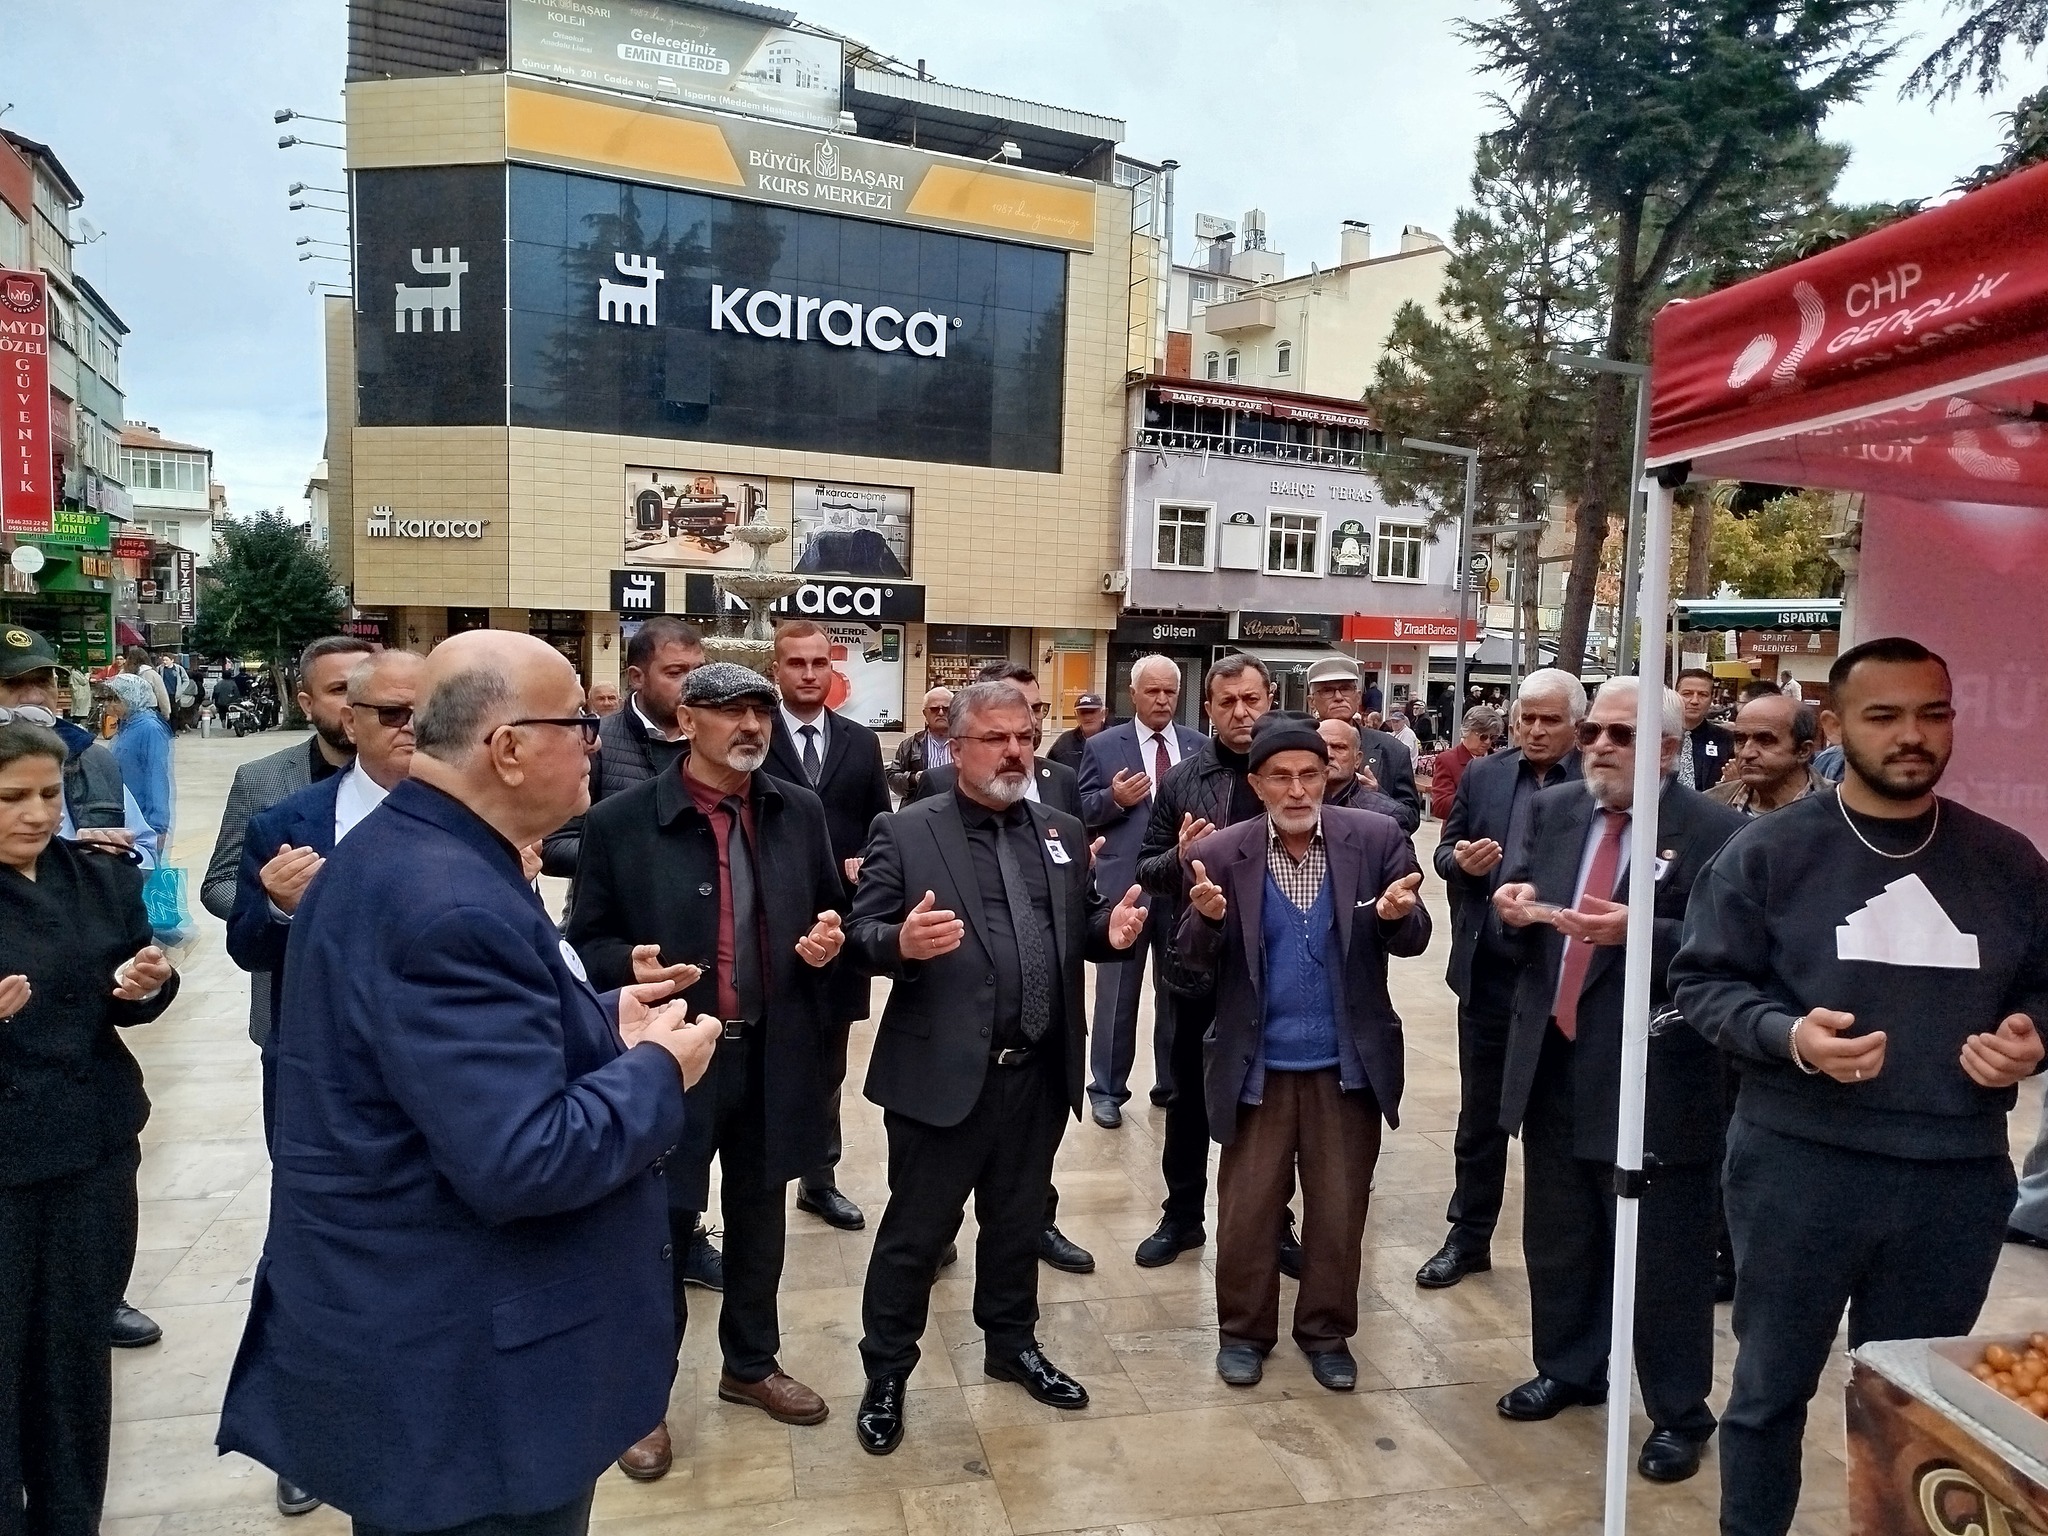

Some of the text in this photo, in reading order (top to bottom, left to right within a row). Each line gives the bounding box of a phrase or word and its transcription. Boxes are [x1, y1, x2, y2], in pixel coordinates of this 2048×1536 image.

[630, 28, 717, 57] Geleceğiniz
[666, 53, 723, 72] ELLERDE
[603, 73, 633, 87] Cadde
[684, 88, 717, 103] Isparta
[748, 148, 905, 191] BÜYÜK BAŞARI
[758, 173, 893, 211] KURS MERKEZİ
[1846, 262, 1922, 318] CHP
[0, 320, 45, 337] MYD
[0, 335, 47, 356] ÖZEL
[1172, 392, 1262, 411] BAHÇE TERAS CAFE
[15, 358, 35, 494] GÜVENLİK
[1290, 409, 1369, 426] BAHÇE TERAS CAFE
[1270, 480, 1374, 502] BAHÇE TERAS
[60, 513, 101, 525] KEBAP
[54, 523, 87, 535] LONU
[116, 548, 150, 557] KEBAP
[119, 540, 146, 548] URFA
[1777, 612, 1829, 624] ISPARTA
[823, 625, 868, 636] ÜNLERDE
[1152, 624, 1196, 640] gülşen
[1403, 623, 1458, 636] Ziraat Bankası
